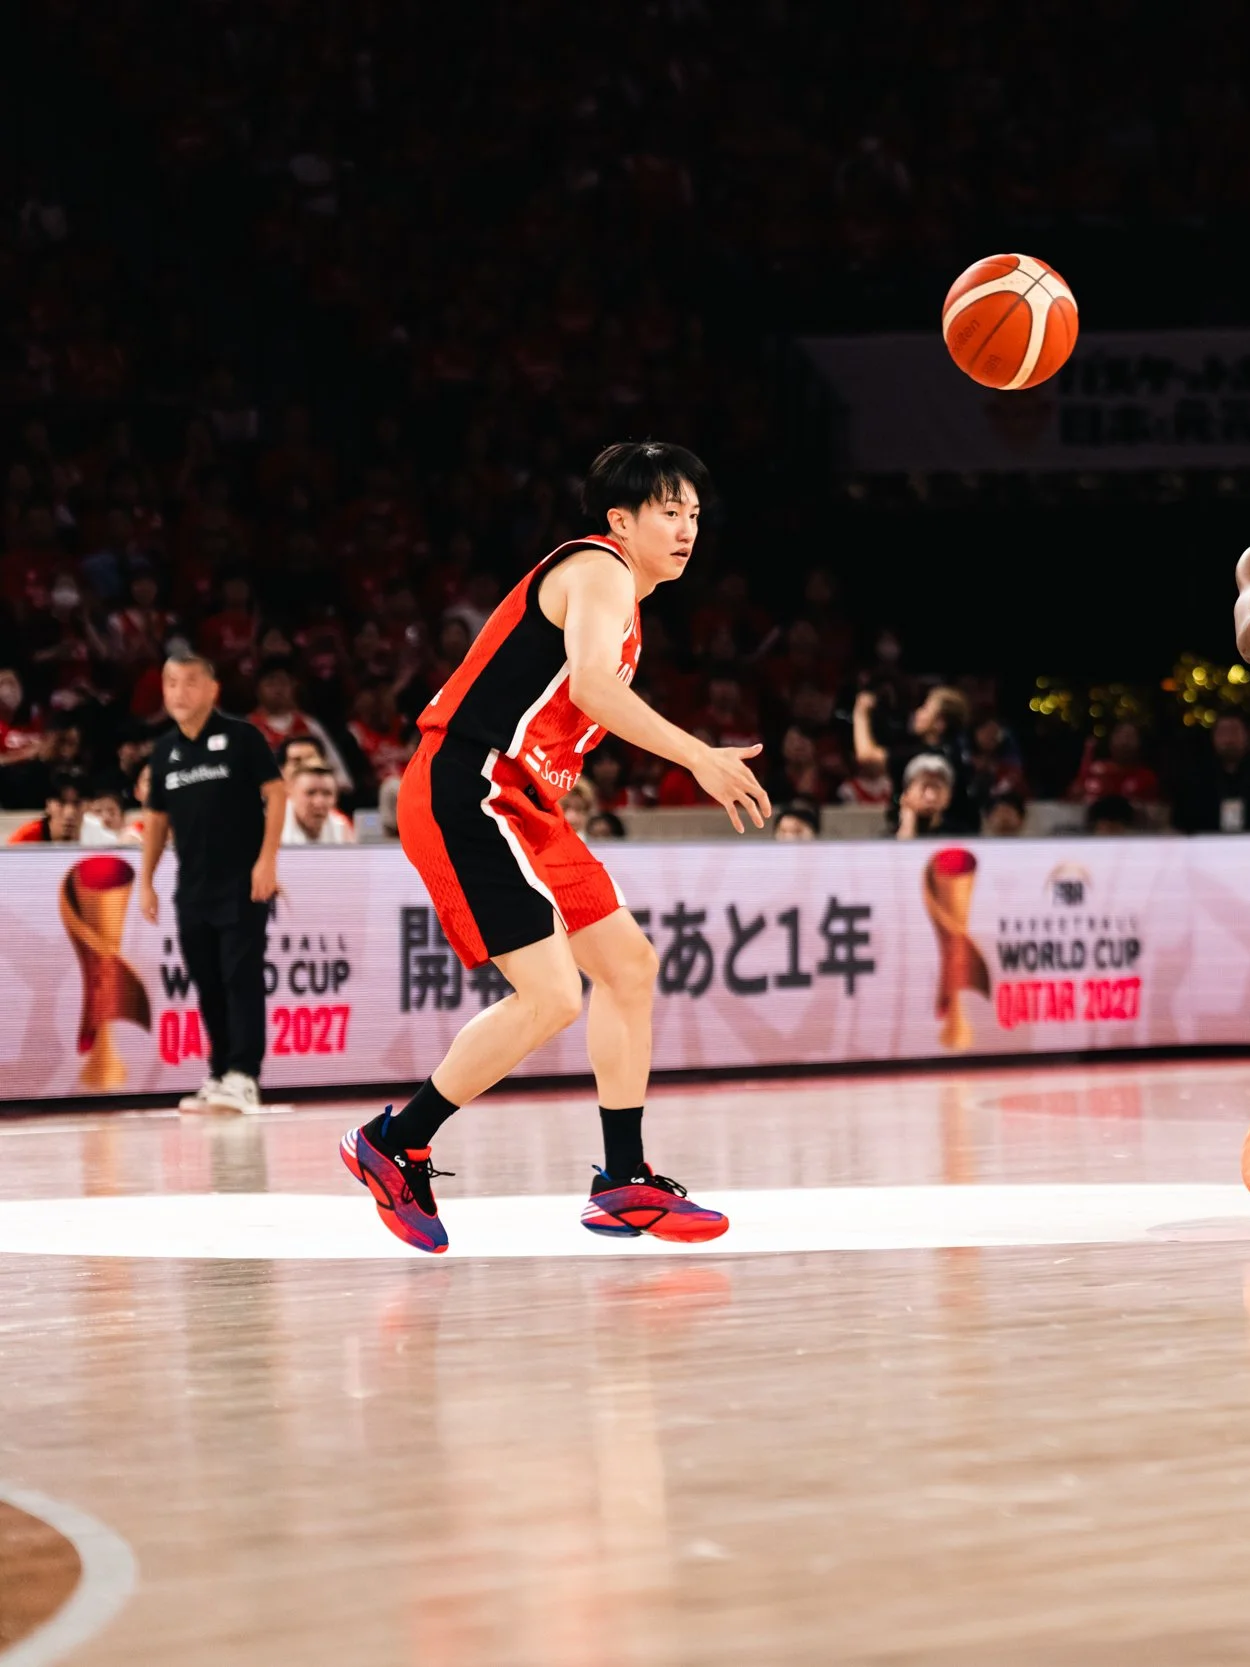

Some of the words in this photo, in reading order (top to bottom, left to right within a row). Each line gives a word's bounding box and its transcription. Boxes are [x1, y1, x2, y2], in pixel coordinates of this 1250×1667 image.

[400, 896, 876, 1012] 開あと1年
[998, 939, 1087, 972] WORLD
[1094, 937, 1141, 970] CUP
[288, 959, 350, 995] CUP
[271, 1003, 350, 1057] 2027
